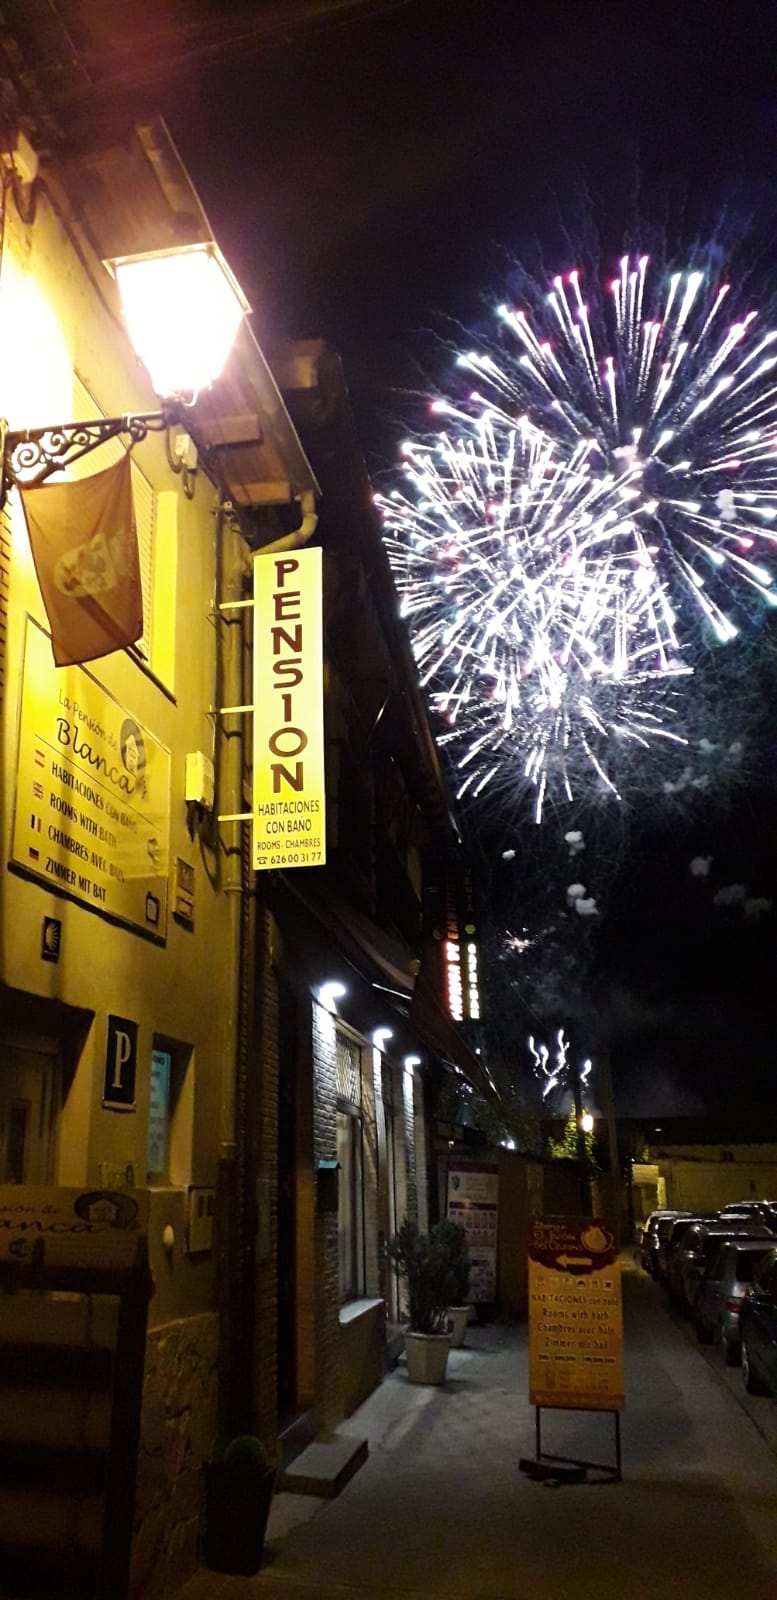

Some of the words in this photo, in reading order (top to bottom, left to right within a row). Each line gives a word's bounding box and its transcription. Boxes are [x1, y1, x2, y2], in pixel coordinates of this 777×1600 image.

[268, 559, 308, 793] PENSION
[56, 717, 135, 794] Blanca
[51, 761, 104, 810] HABITACIONES
[50, 793, 78, 823] ROOMS
[80, 812, 98, 837] WITH
[258, 799, 320, 816] HABITACIONES
[265, 820, 285, 834] CON
[48, 825, 89, 862] CHAMBRES
[91, 851, 107, 870] AVEC
[270, 854, 287, 864] 626
[285, 837, 321, 849] CHAMBRES
[45, 856, 77, 886] ZIMMER
[78, 875, 91, 894] MIT
[111, 1030, 132, 1089] P
[532, 1294, 586, 1304] HABITACIONES
